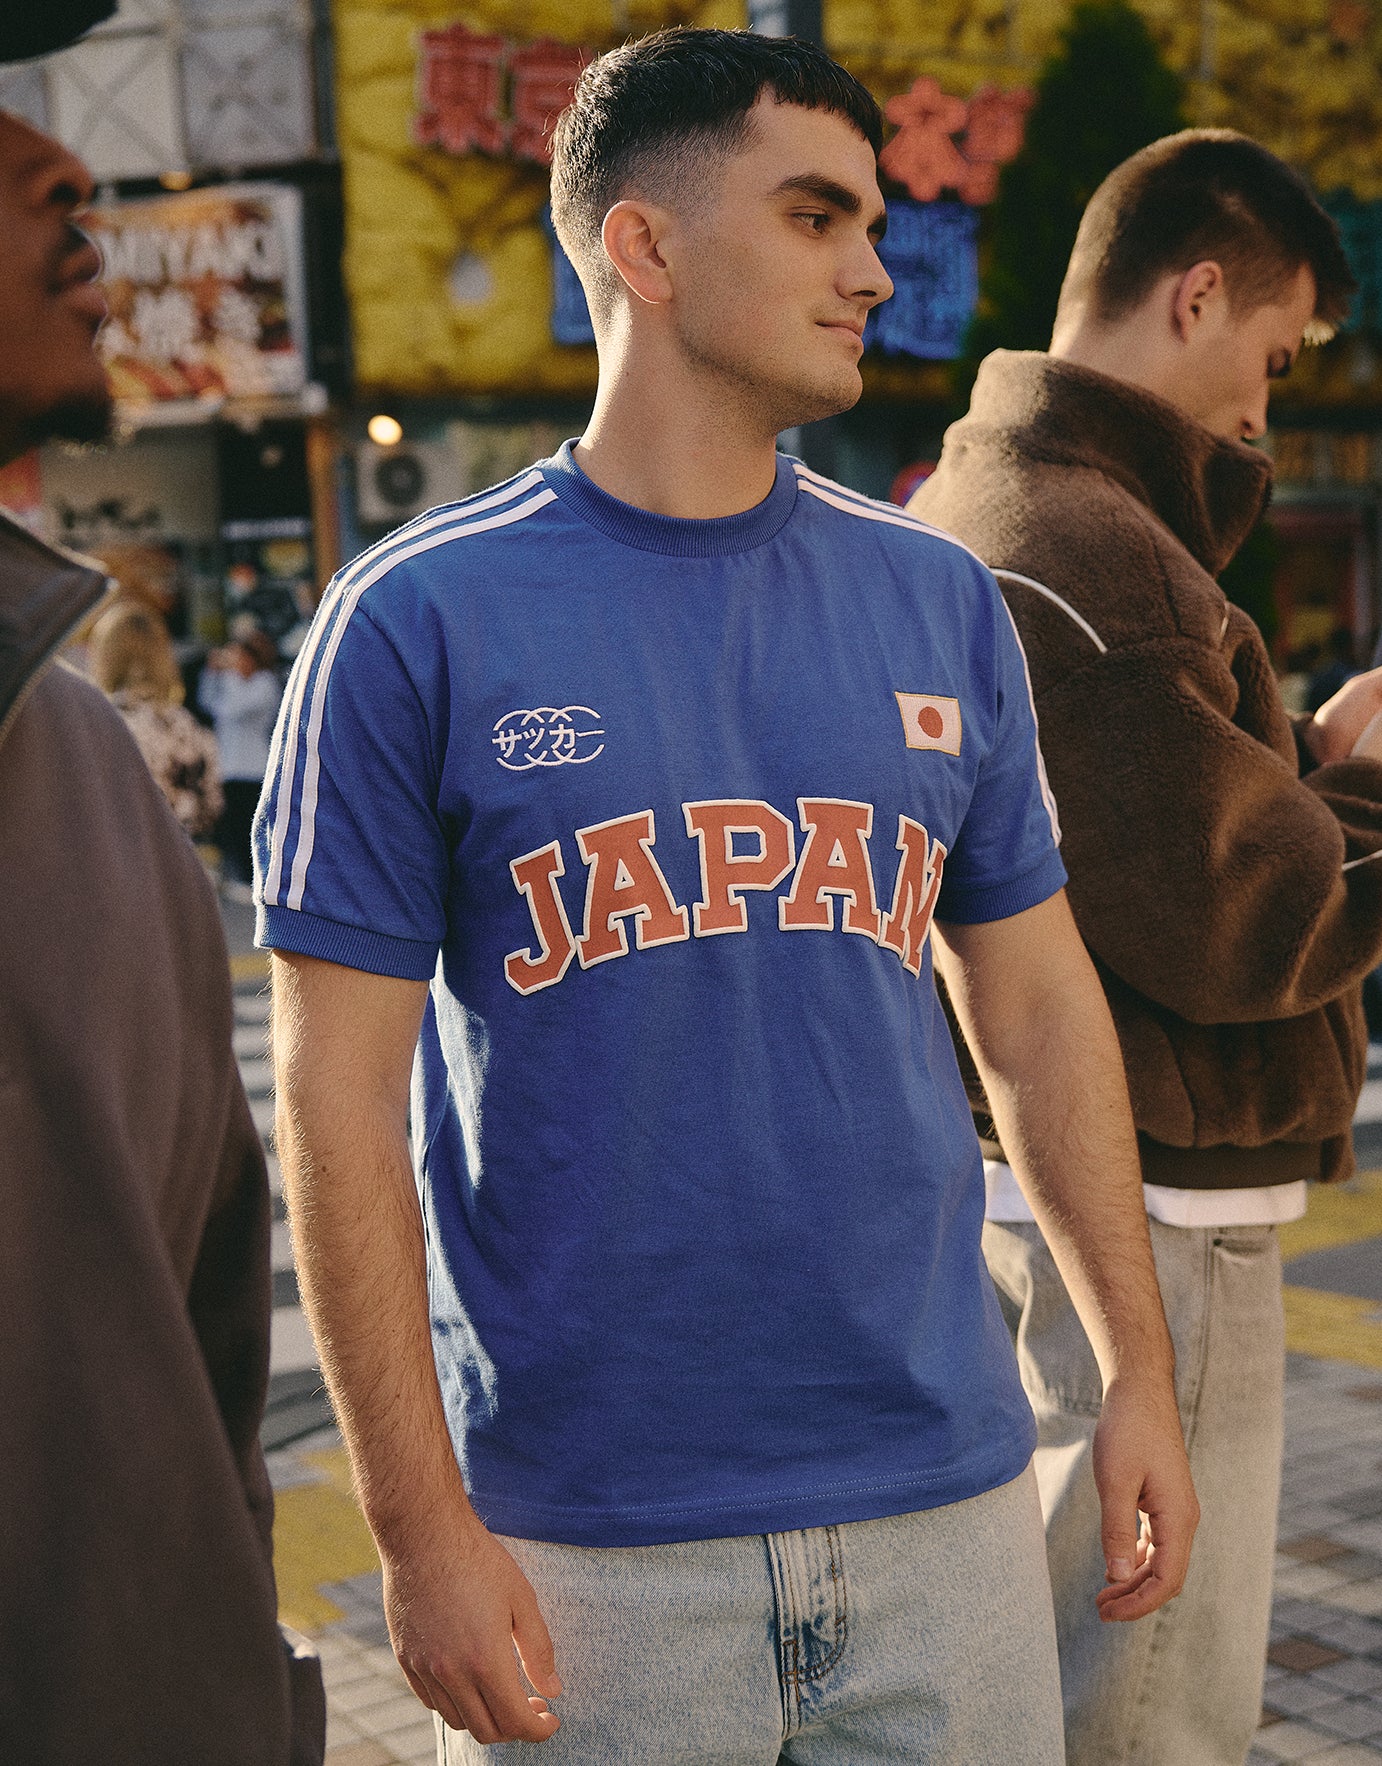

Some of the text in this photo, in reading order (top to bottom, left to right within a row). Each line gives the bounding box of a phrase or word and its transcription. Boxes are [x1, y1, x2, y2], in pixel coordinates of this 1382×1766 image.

[491, 723, 606, 759] サッカー
[504, 797, 947, 995] JAPAN
